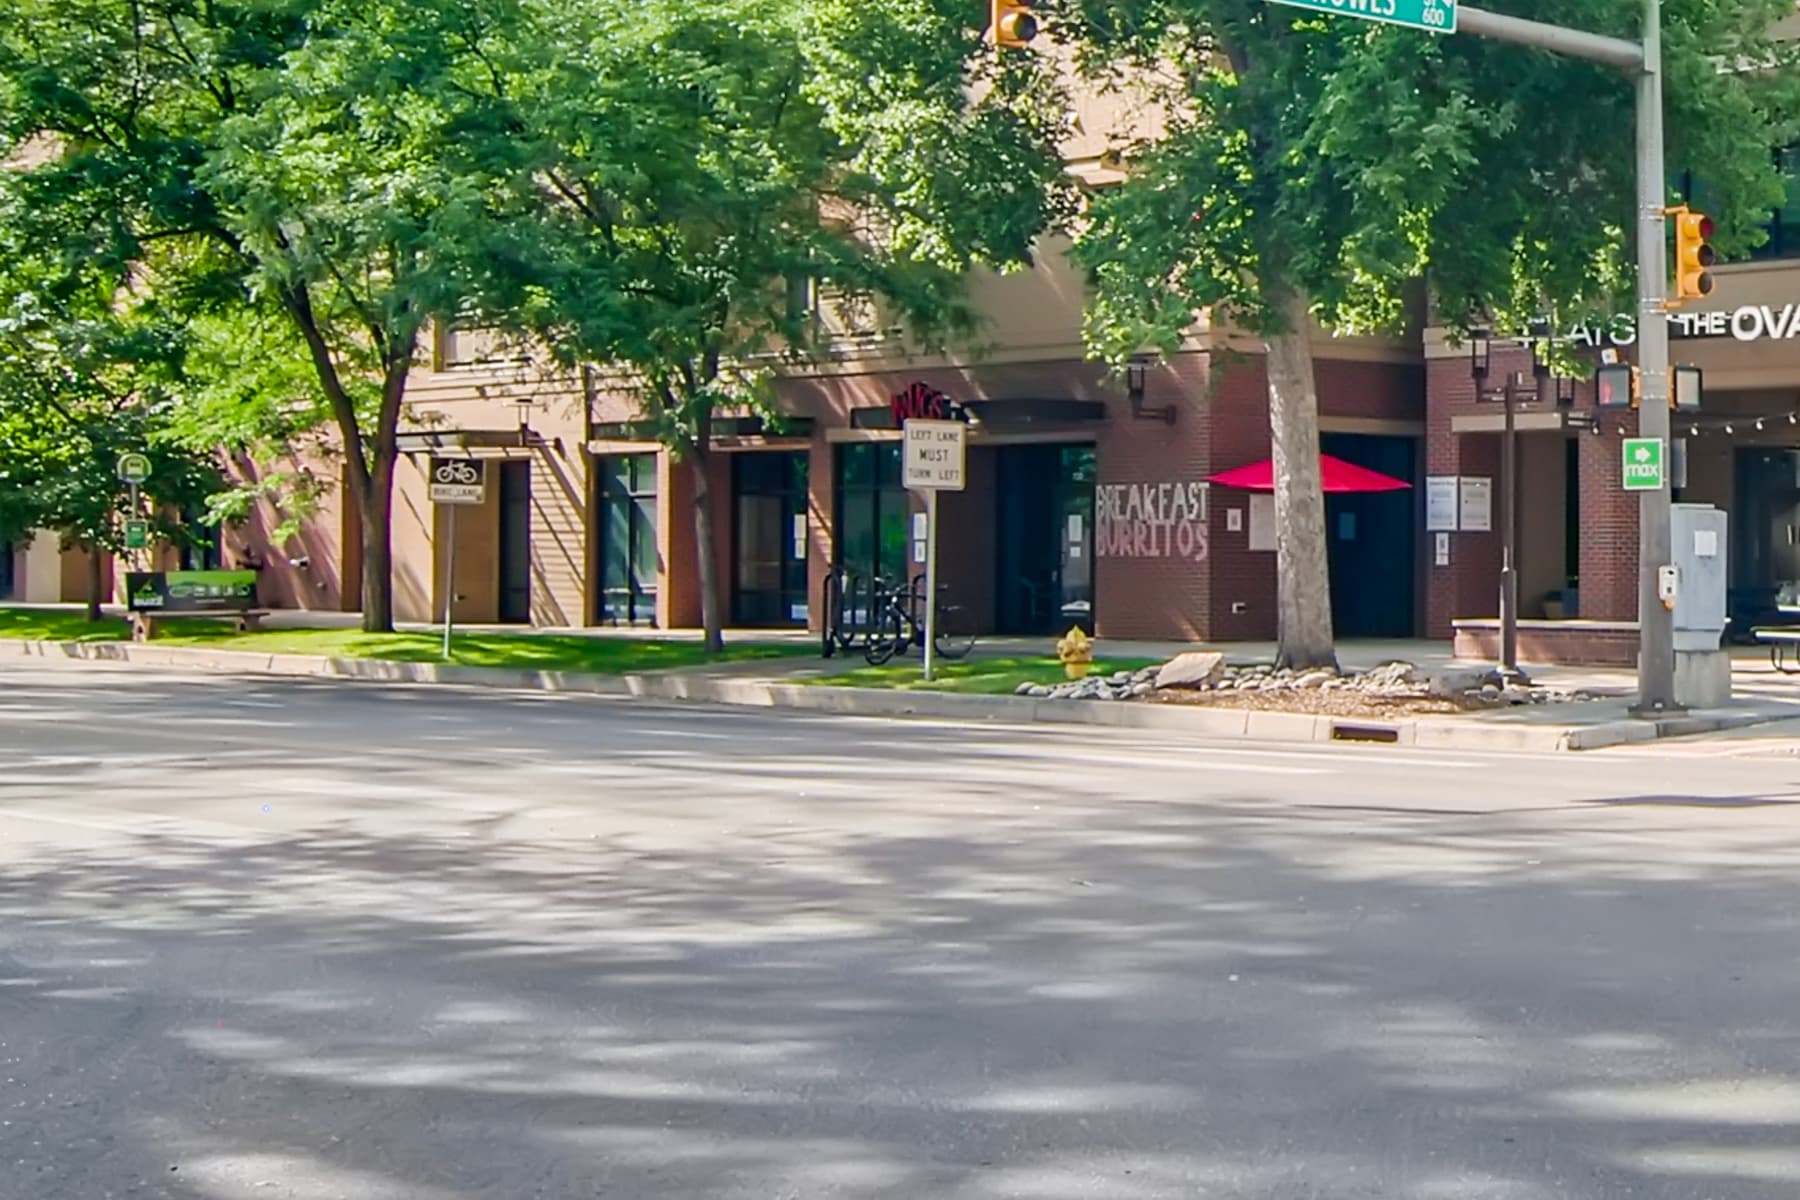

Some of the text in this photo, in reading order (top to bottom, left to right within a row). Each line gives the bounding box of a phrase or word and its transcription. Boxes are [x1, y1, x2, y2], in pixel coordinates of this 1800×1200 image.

[1422, 8, 1445, 26] 600
[1680, 312, 1727, 336] THE
[910, 429, 960, 442] LEFT LANE
[919, 448, 949, 462] MUST
[908, 467, 960, 481] TURN LEFT
[1626, 463, 1659, 478] max
[1095, 482, 1210, 523] BREAKFAST
[1095, 520, 1209, 561] BURRITOS
